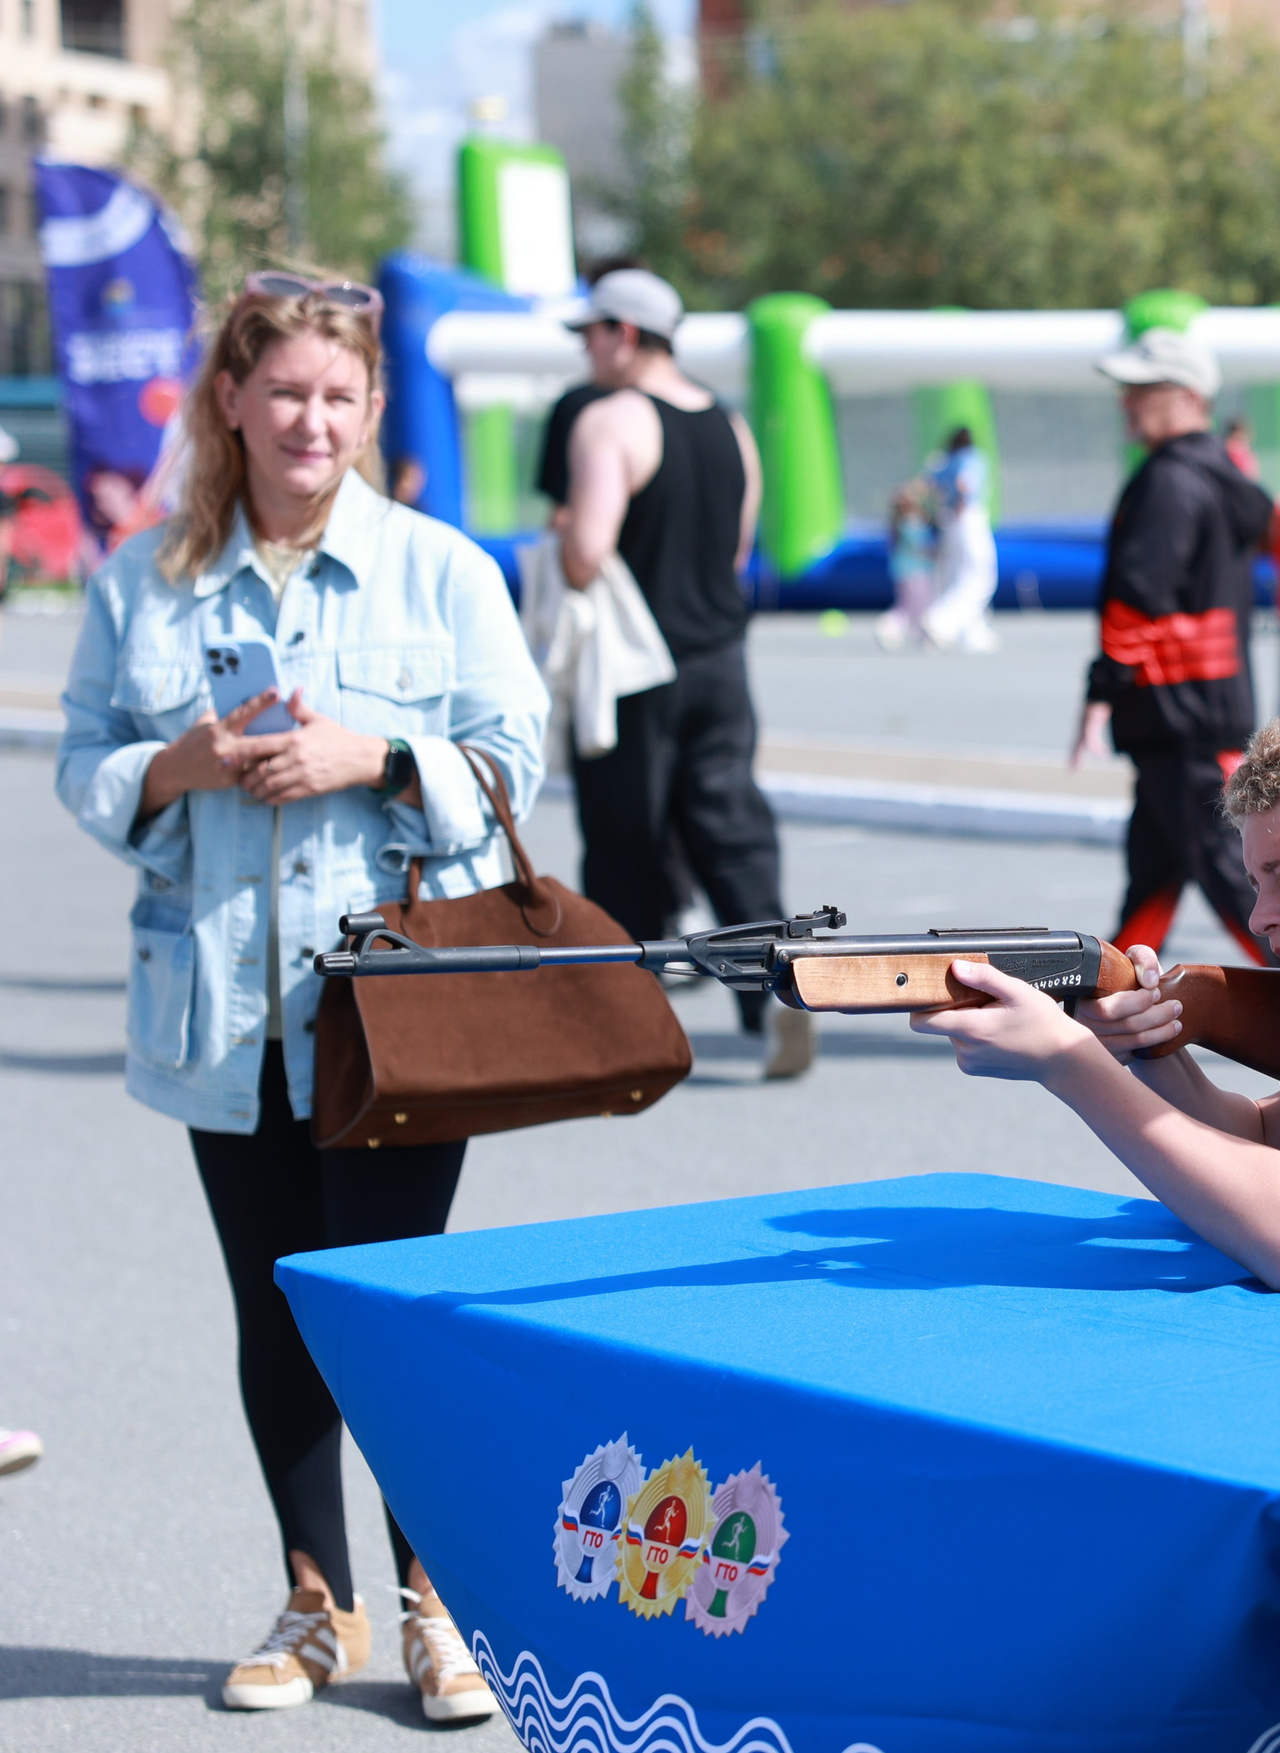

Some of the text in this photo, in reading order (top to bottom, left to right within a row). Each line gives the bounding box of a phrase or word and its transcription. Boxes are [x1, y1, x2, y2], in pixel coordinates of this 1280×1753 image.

[582, 1530, 603, 1549] ГТО
[646, 1546, 669, 1564] ГТО
[715, 1563, 738, 1582] ГТО
